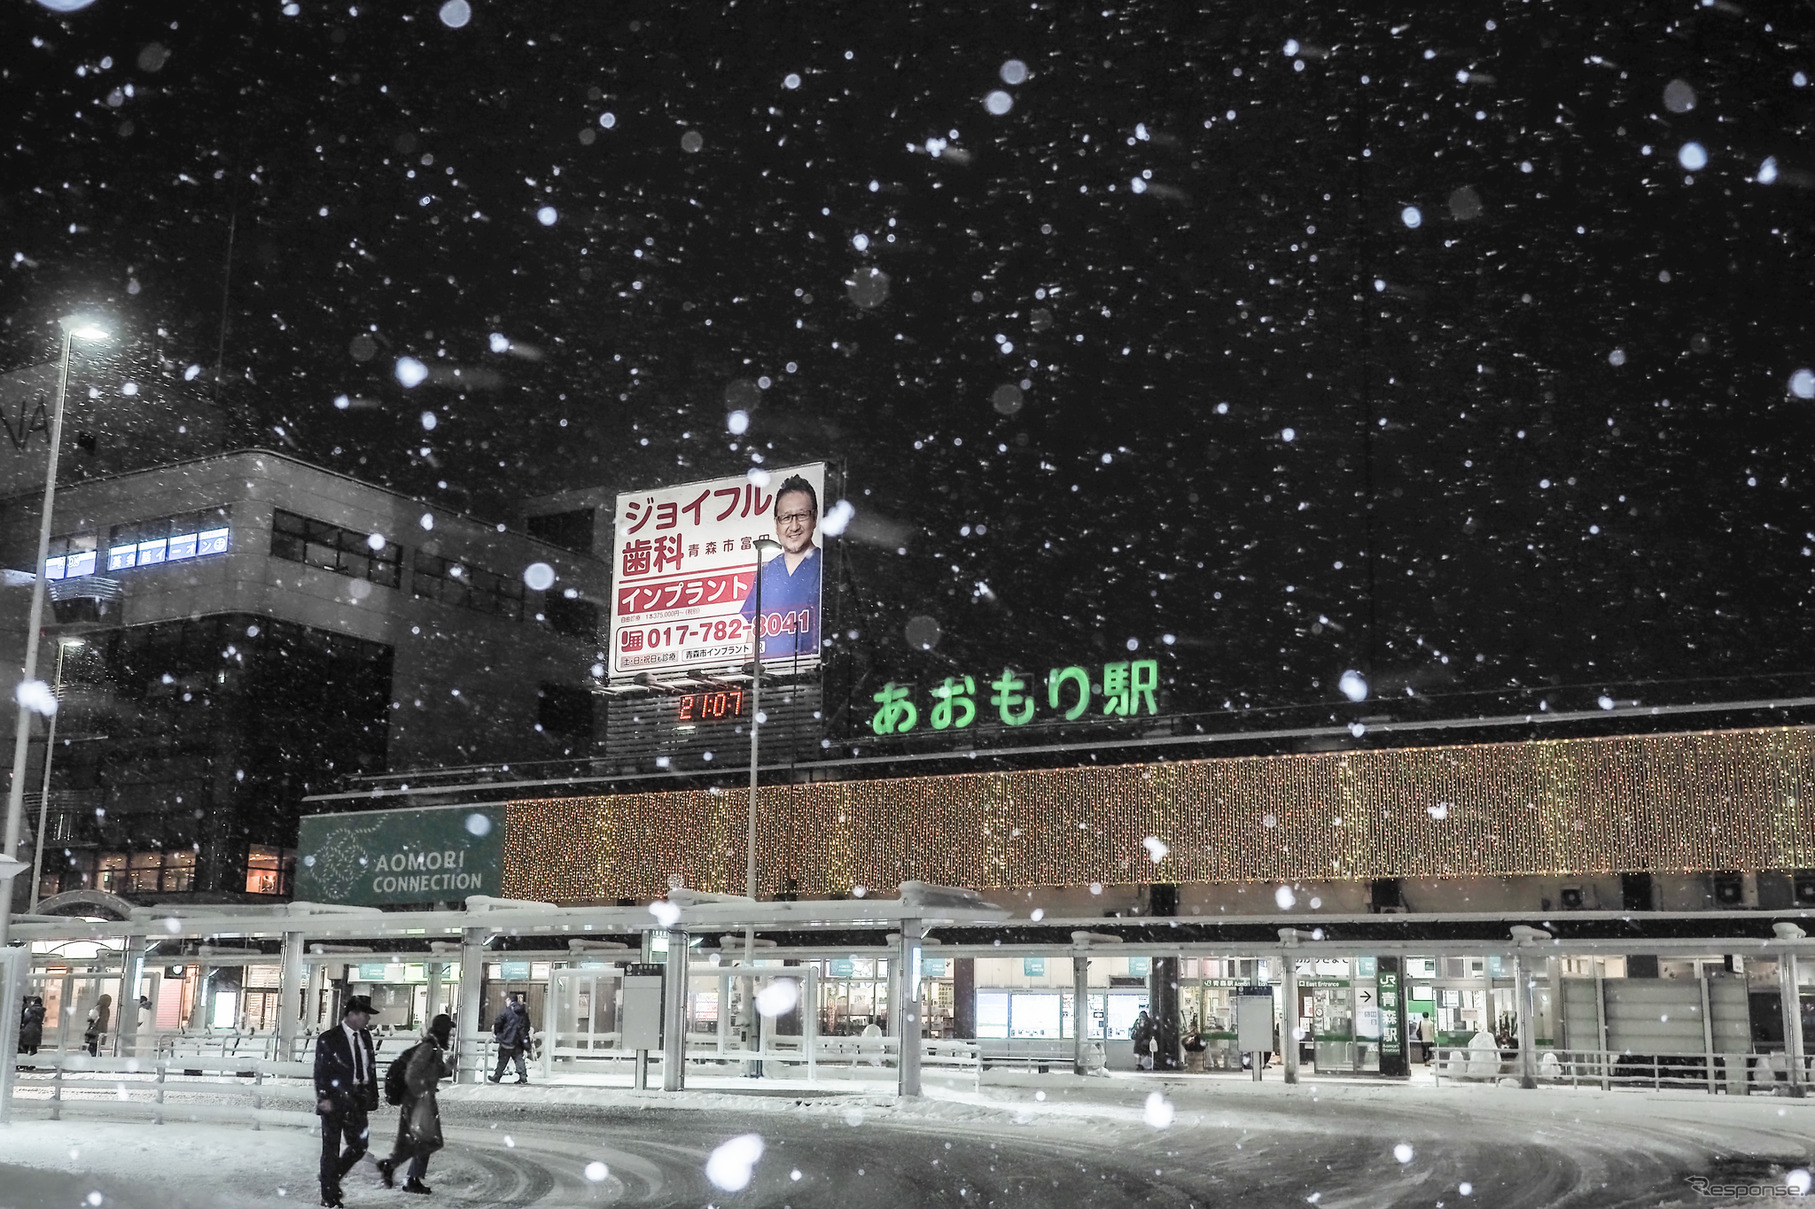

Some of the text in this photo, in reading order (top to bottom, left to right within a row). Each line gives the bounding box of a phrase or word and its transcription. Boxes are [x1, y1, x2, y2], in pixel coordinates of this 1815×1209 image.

[626, 483, 772, 535] ジョイフル
[622, 533, 684, 576] 歯科
[622, 575, 748, 612] インプラント
[647, 610, 809, 648] 017-782-8041
[686, 645, 749, 659] 青森市インプラント
[679, 691, 742, 719] 21:07
[873, 659, 1157, 735] あおもり駅
[375, 850, 464, 872] AOMORI
[372, 873, 482, 893] CONNECTION
[1380, 974, 1396, 984] JR
[1382, 992, 1398, 1042] 青森駅
